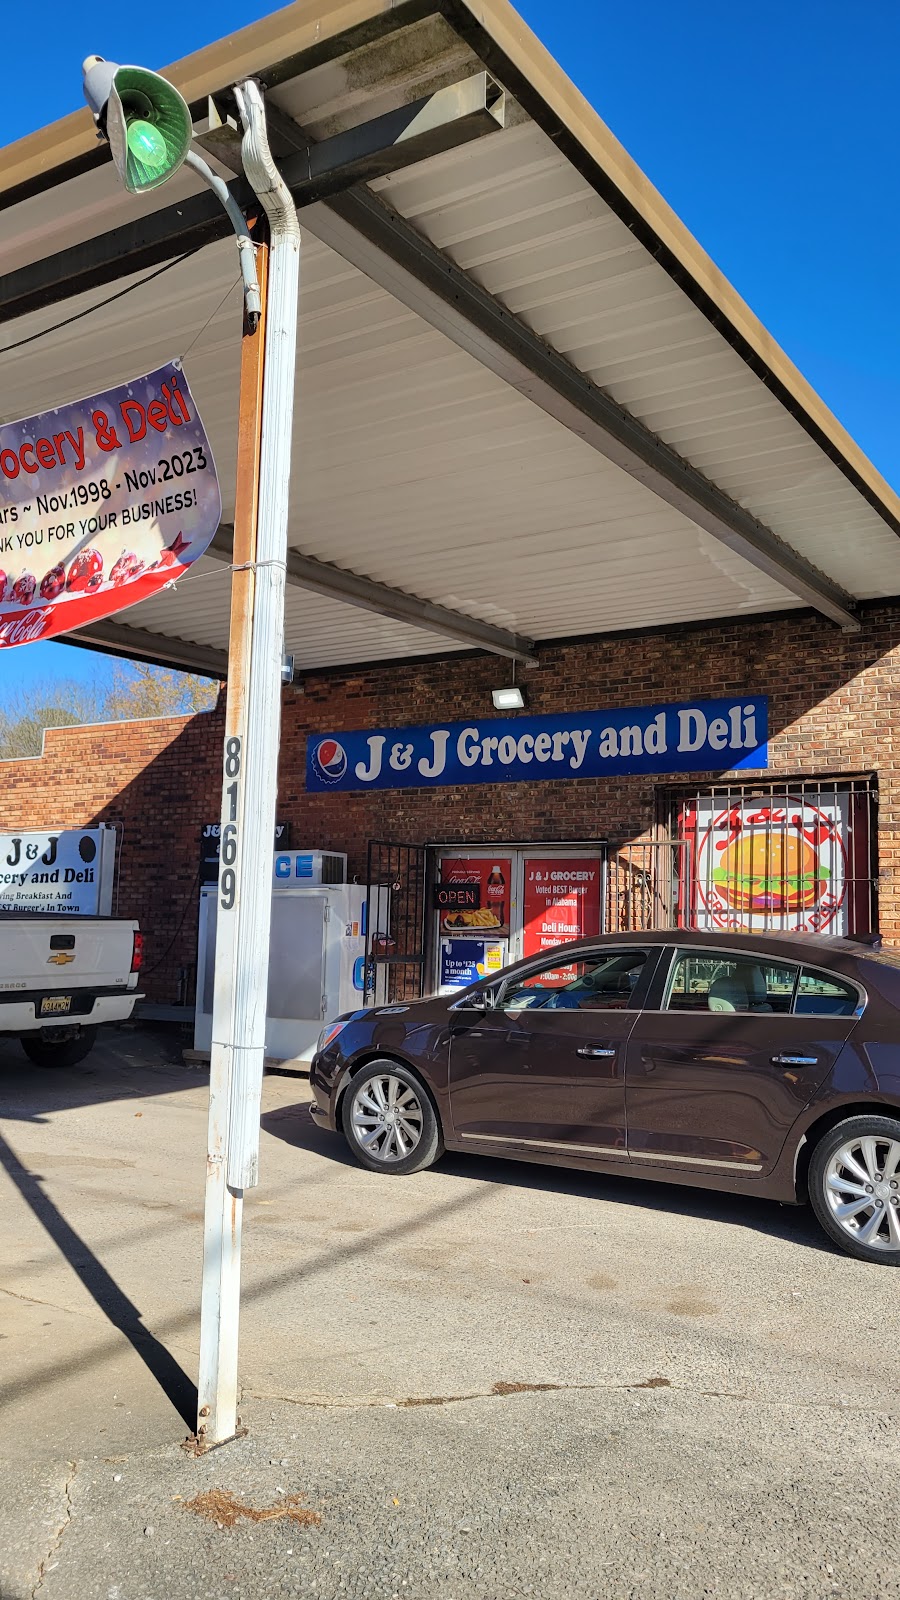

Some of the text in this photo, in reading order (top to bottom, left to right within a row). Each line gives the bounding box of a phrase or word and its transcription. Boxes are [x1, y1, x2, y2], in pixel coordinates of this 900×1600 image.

[0, 375, 191, 479] ocery & Deli
[36, 478, 112, 515] Nov.1998
[124, 446, 207, 493] Nov.2023
[17, 527, 44, 548] YOU
[48, 522, 76, 543] FOR
[79, 513, 118, 537] YOUR
[122, 488, 198, 525] BUSINESS!
[354, 704, 758, 781] J & J Grocery and Deli
[220, 736, 241, 910] 8169
[6, 836, 59, 866] J & J
[275, 854, 314, 878] CE
[31, 869, 60, 884] and
[63, 868, 94, 883] Deli
[529, 871, 596, 881] J & J GROCERY
[16, 891, 53, 900] Breakfast
[55, 891, 72, 900] And
[438, 890, 475, 904] OPEN
[535, 885, 588, 896] Voted BEST Burger
[14, 903, 45, 912] Burger's
[47, 903, 55, 911] In
[57, 903, 80, 912] Town
[545, 897, 577, 907] in Alabama
[542, 922, 581, 933] Deli Hours
[445, 960, 455, 968] Up
[450, 967, 472, 976] month
